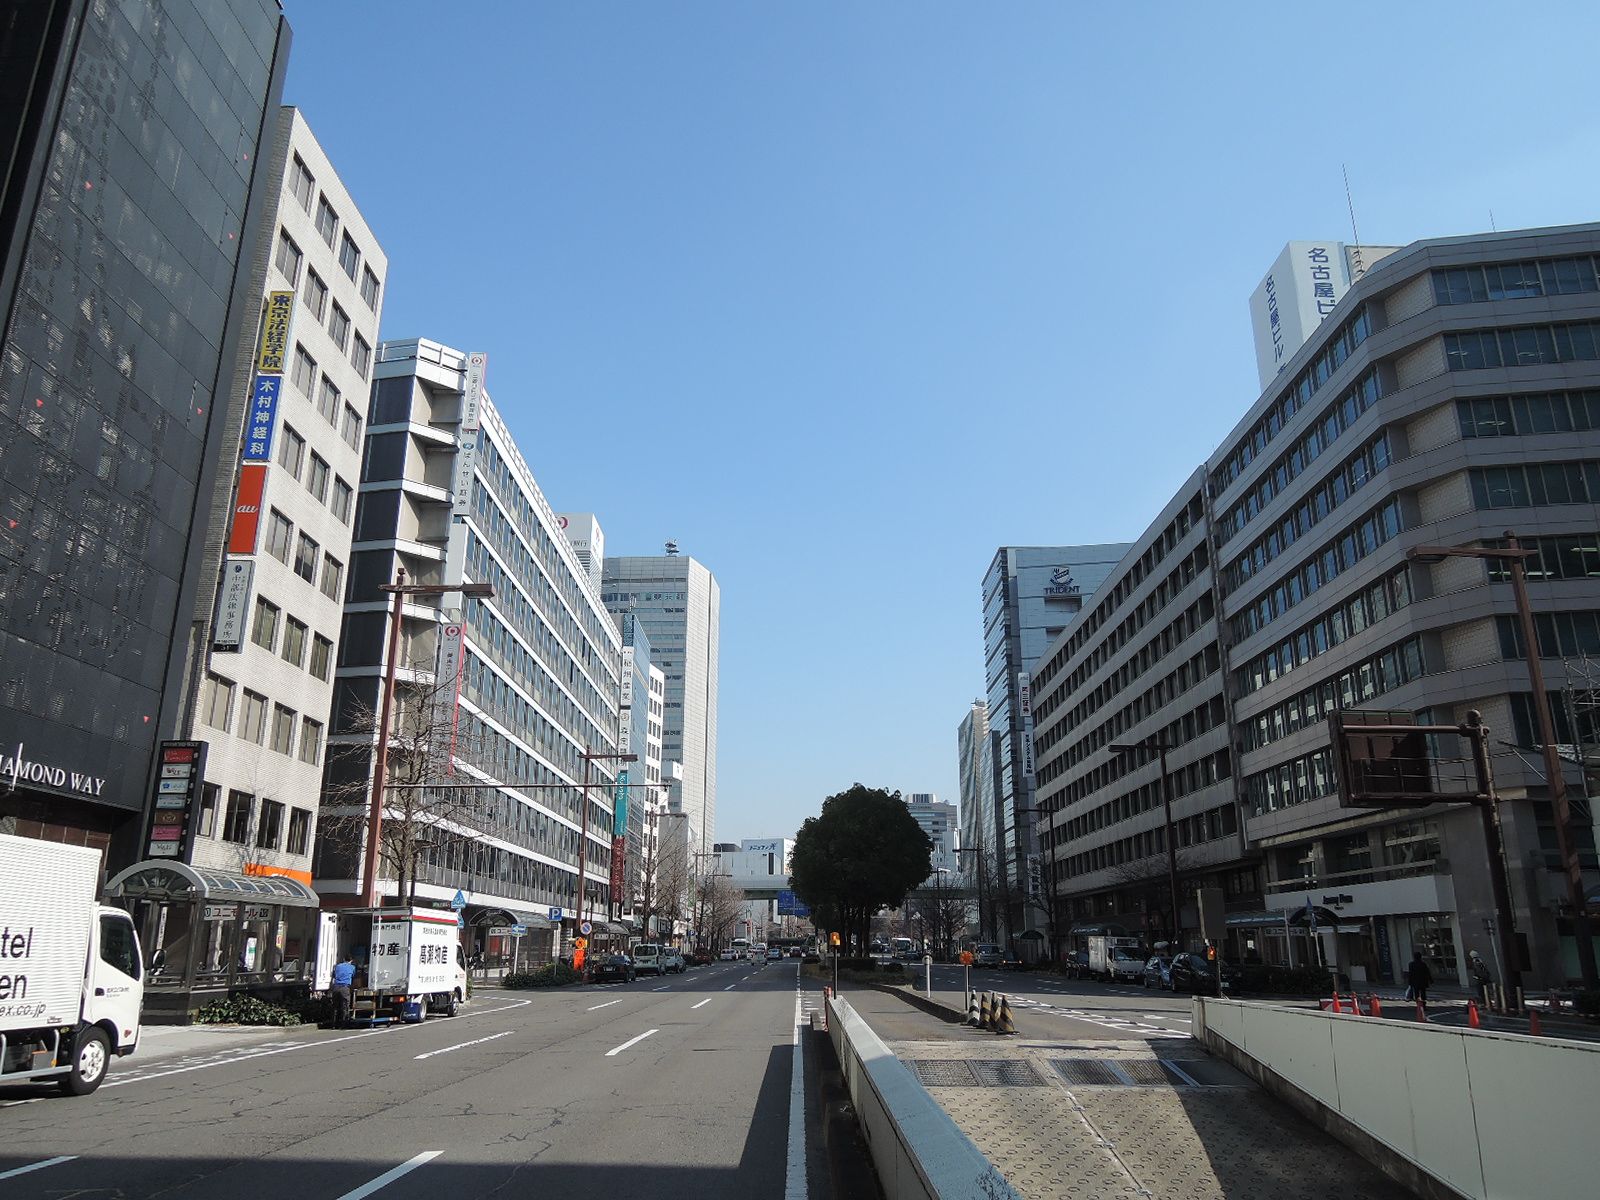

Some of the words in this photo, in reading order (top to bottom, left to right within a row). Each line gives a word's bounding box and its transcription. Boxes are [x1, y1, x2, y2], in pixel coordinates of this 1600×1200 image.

[1308, 247, 1336, 323] 名古屋ビ
[262, 294, 291, 368] 東京法経学院
[250, 380, 275, 455] 木村神経科
[237, 505, 258, 513] au
[1043, 586, 1080, 594] TRIDENT
[71, 772, 106, 795] WAY
[552, 909, 560, 919] P
[371, 942, 401, 957] 物産
[420, 944, 448, 965] 高瀬物産
